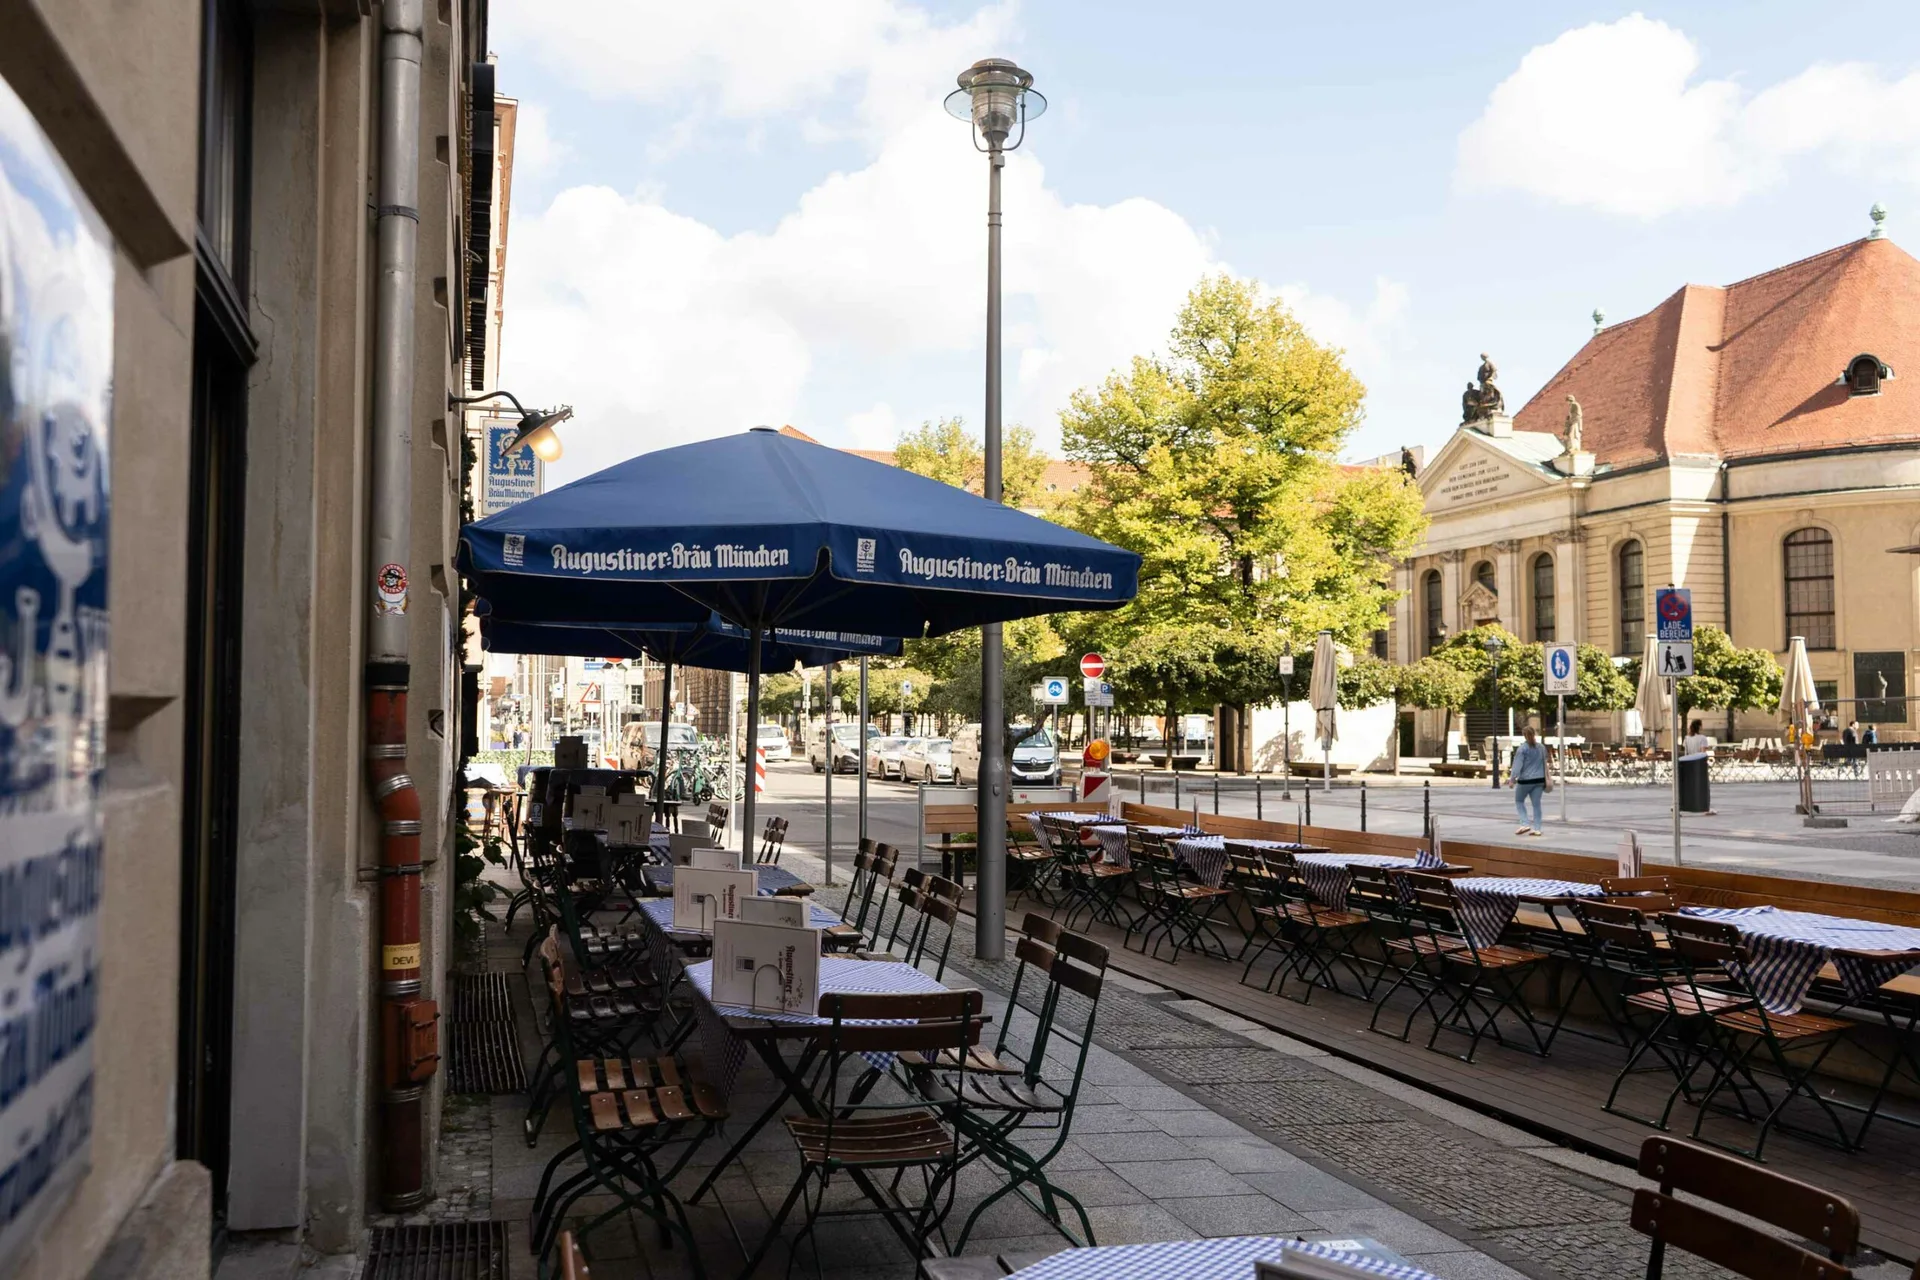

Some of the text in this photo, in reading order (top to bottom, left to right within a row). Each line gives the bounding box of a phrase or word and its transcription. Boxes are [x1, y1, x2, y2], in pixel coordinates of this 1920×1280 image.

[488, 487, 534, 499] Bräu München
[714, 543, 789, 568] München
[1044, 562, 1113, 591] München
[1663, 620, 1686, 630] LADE-
[1660, 629, 1690, 639] BEREICH
[1553, 681, 1568, 689] ZONE
[785, 945, 796, 994] Augustiner
